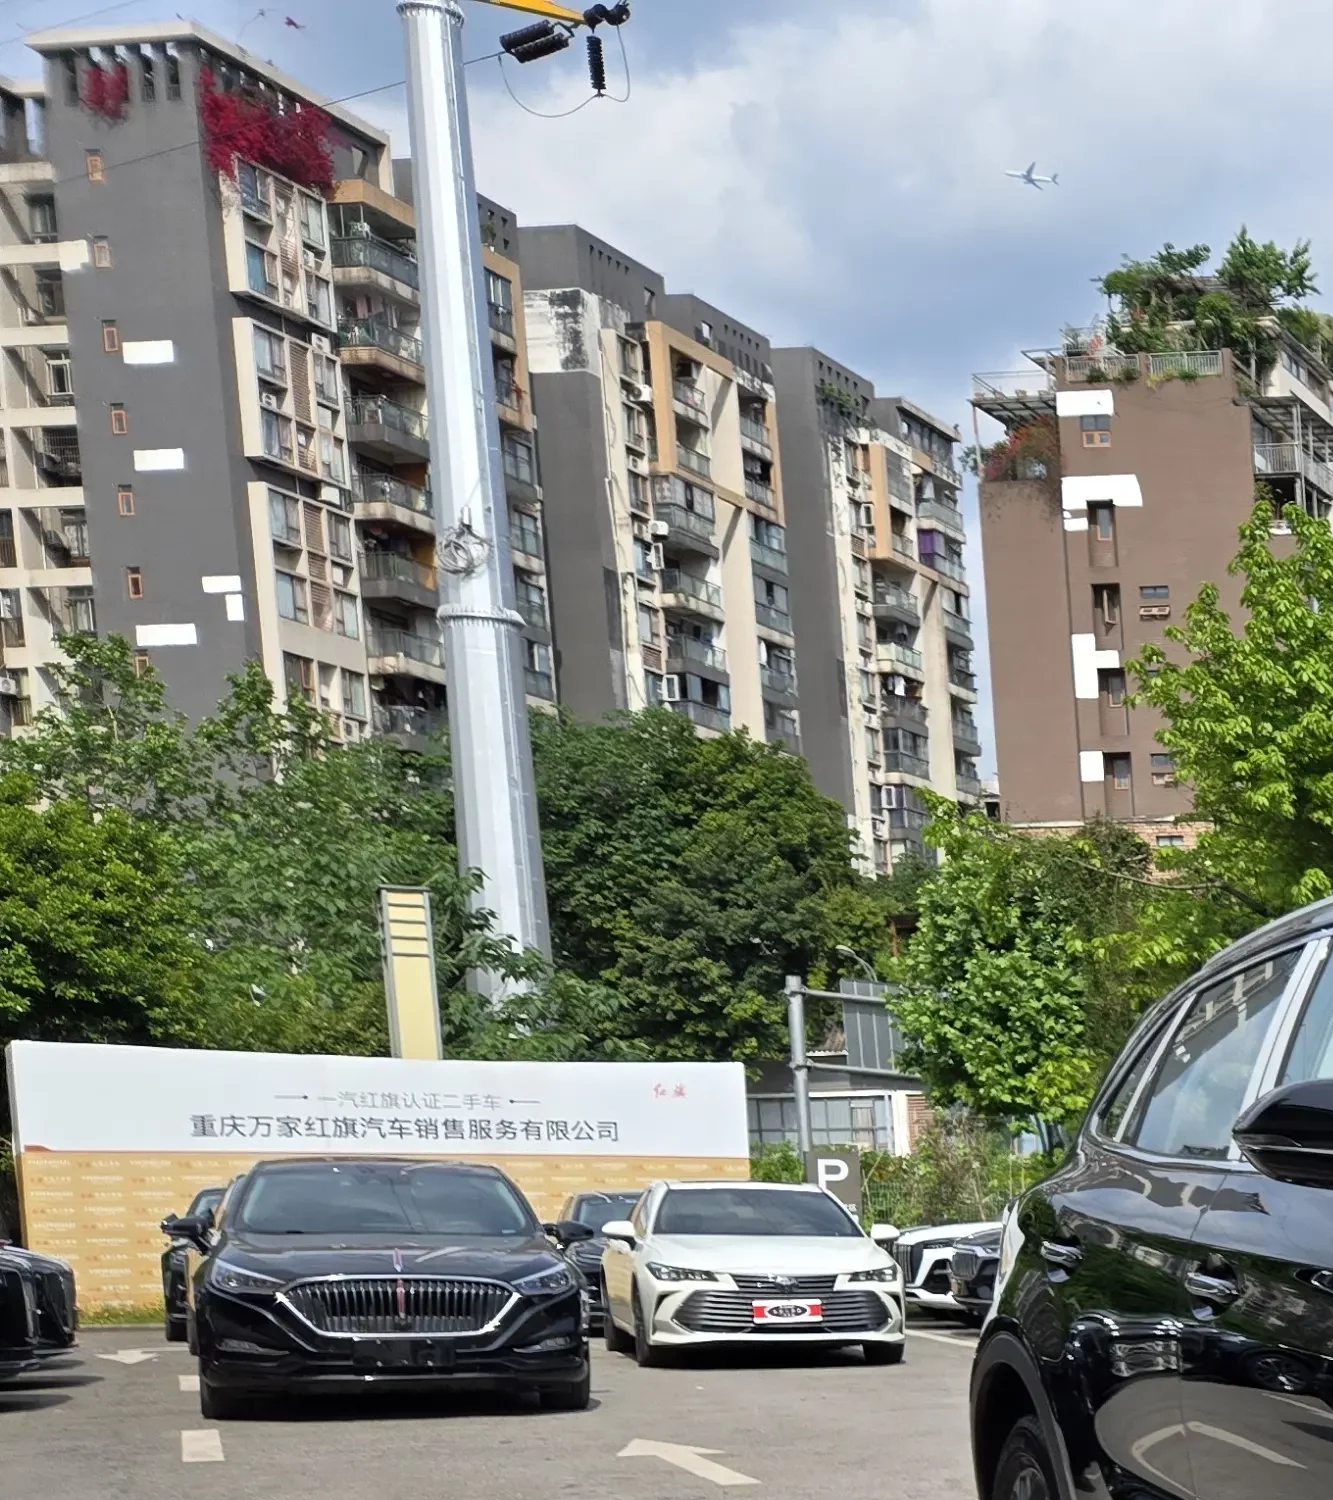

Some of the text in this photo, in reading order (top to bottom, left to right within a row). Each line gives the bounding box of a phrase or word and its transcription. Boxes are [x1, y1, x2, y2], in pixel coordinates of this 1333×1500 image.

[317, 1091, 502, 1111] 一汽红旗认证二手车
[190, 1114, 619, 1142] 重庆万家红旗汽车销售服务有限公司
[817, 1158, 849, 1191] P
